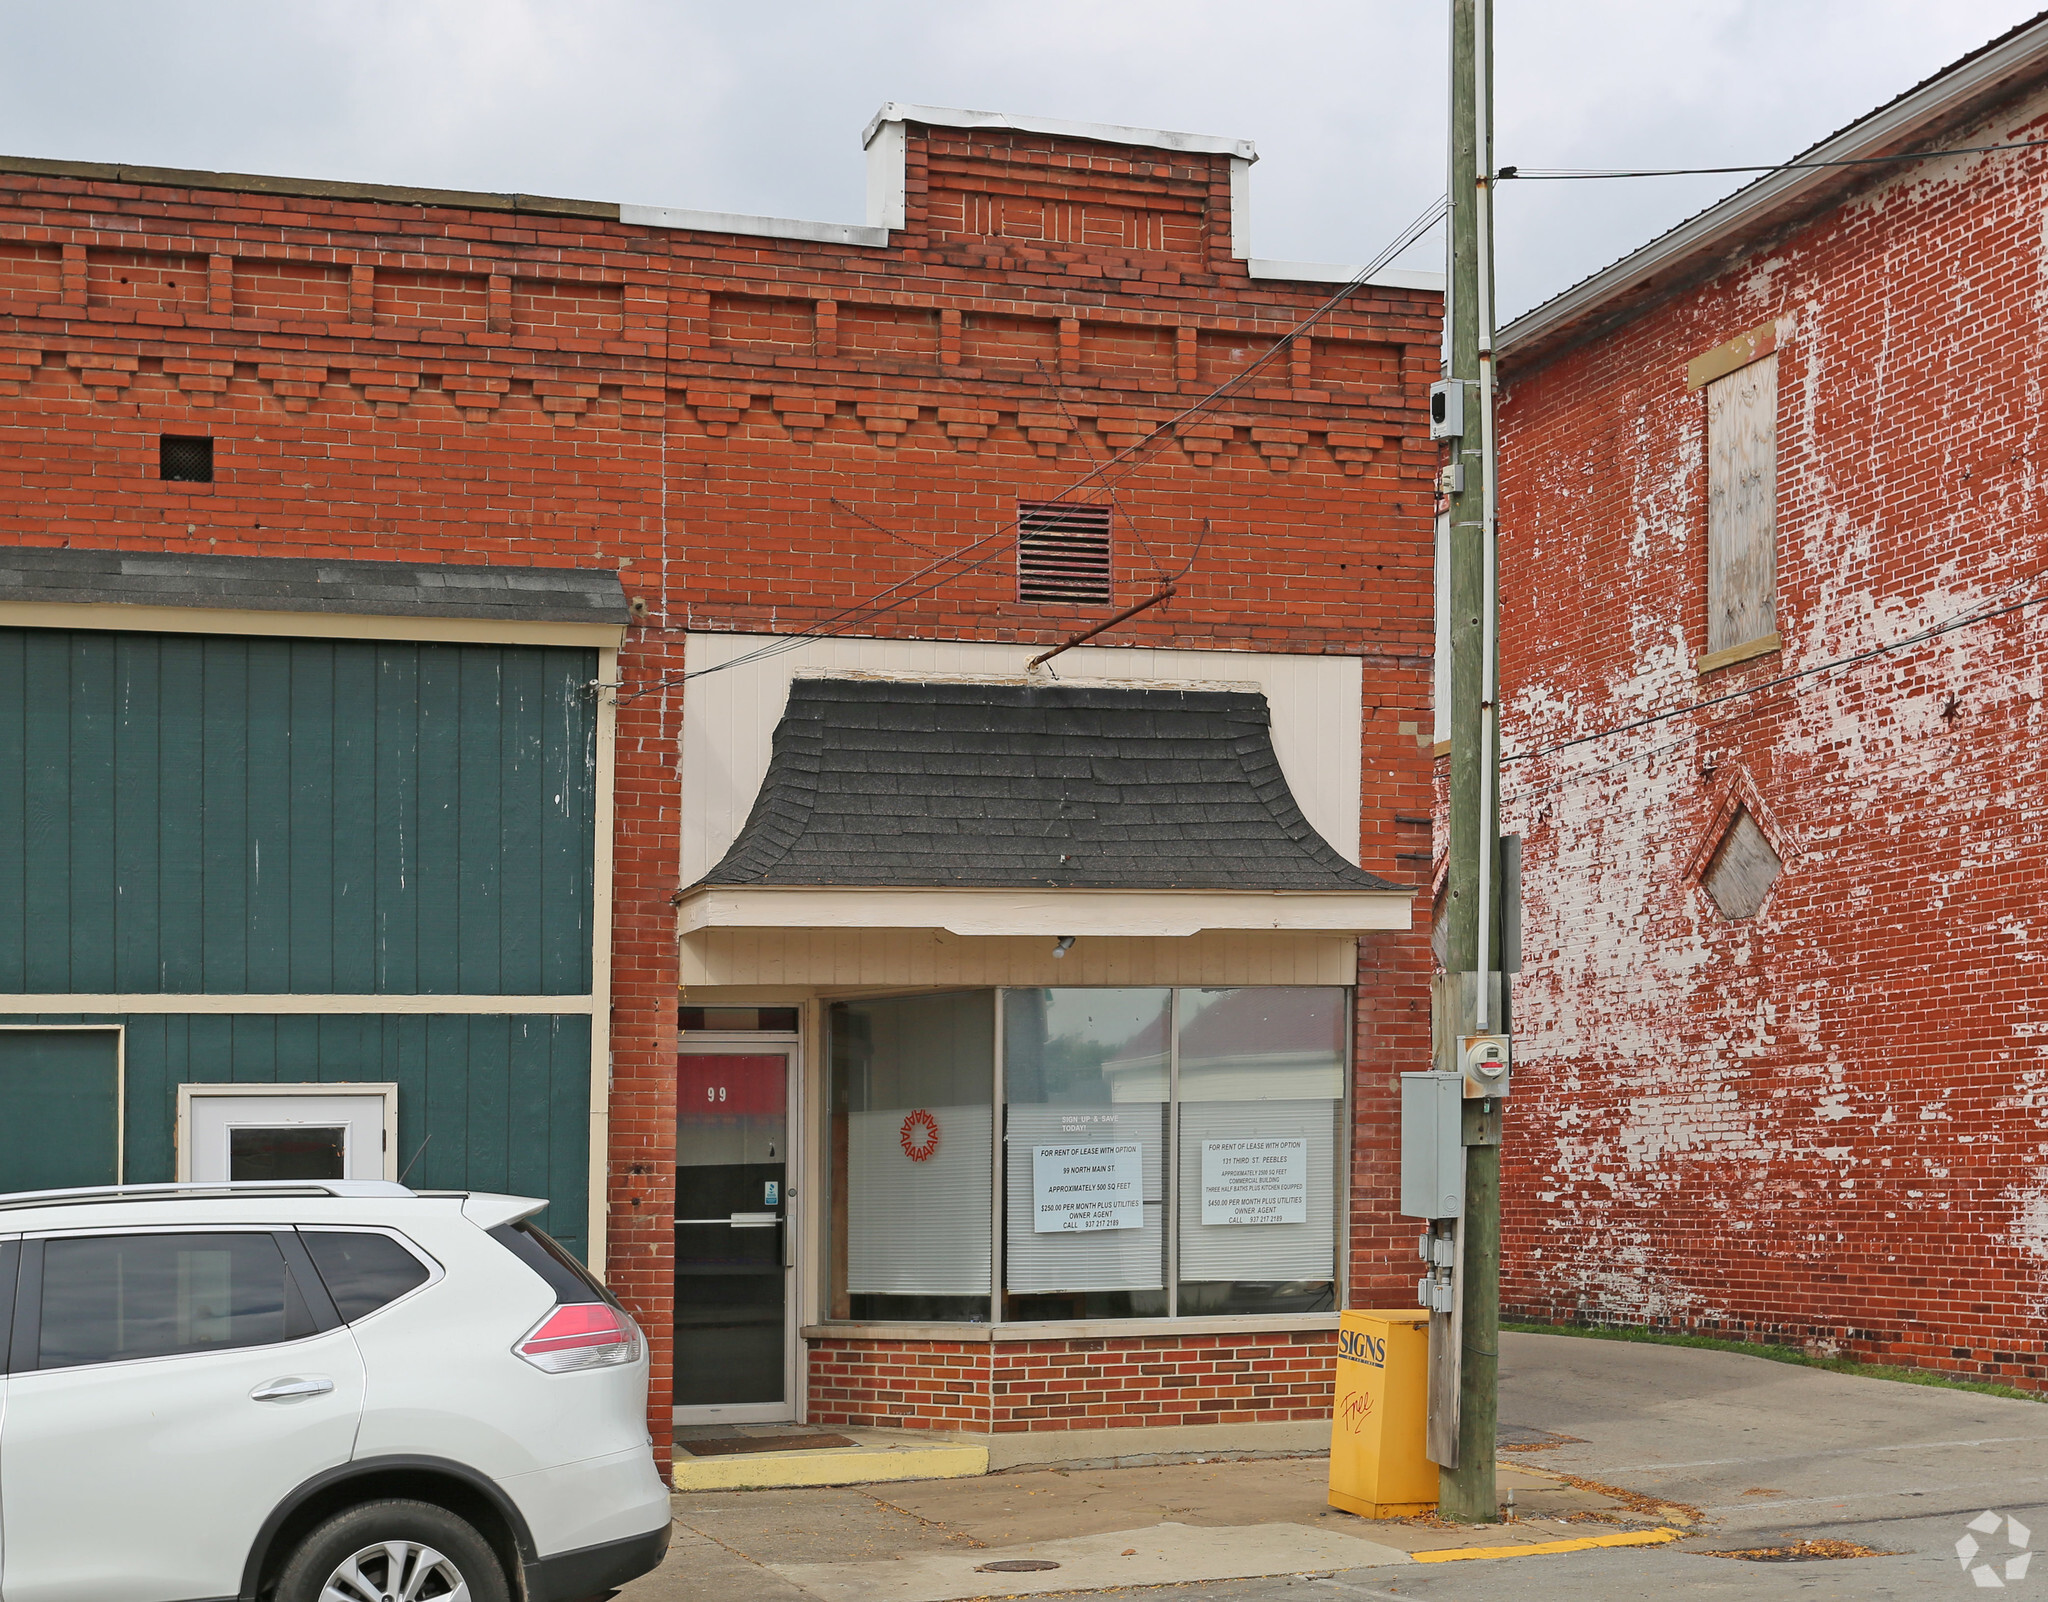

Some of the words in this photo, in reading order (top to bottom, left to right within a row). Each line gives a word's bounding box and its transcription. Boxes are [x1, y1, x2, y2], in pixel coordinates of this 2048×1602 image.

[707, 1086, 727, 1103] 99
[1246, 1142, 1264, 1150] LEASE
[1280, 1141, 1301, 1149] OPTION
[1041, 1149, 1053, 1157] FOR
[1054, 1148, 1070, 1156] RENT
[1080, 1147, 1099, 1155] LEASE
[1100, 1146, 1115, 1154] WITH
[1262, 1155, 1288, 1163] PEEBLES
[1071, 1166, 1091, 1174] NORTH
[1092, 1165, 1107, 1173] MAIN
[1048, 1183, 1096, 1193] APPROXIMATELY
[1097, 1183, 1106, 1191] 500
[1117, 1182, 1131, 1190] FEET
[1041, 1204, 1062, 1212] $250.00
[1063, 1203, 1074, 1211] PER
[1075, 1202, 1096, 1210] MONTH
[1097, 1201, 1112, 1209] PLUS
[1113, 1200, 1139, 1208] UTILITIES
[1208, 1199, 1228, 1207] $450.00
[1228, 1198, 1240, 1206] PER
[1277, 1196, 1302, 1204] UTILITIES
[1093, 1211, 1113, 1219] AGENT
[1234, 1207, 1255, 1215] OWNER
[1257, 1206, 1277, 1214] AGENT
[1063, 1221, 1078, 1229] CALL
[1085, 1220, 1095, 1228] 937
[1106, 1219, 1119, 1227] 2189
[1228, 1216, 1243, 1224] CALL
[1338, 1329, 1386, 1363] SIGNS
[1340, 1391, 1374, 1434] Free
